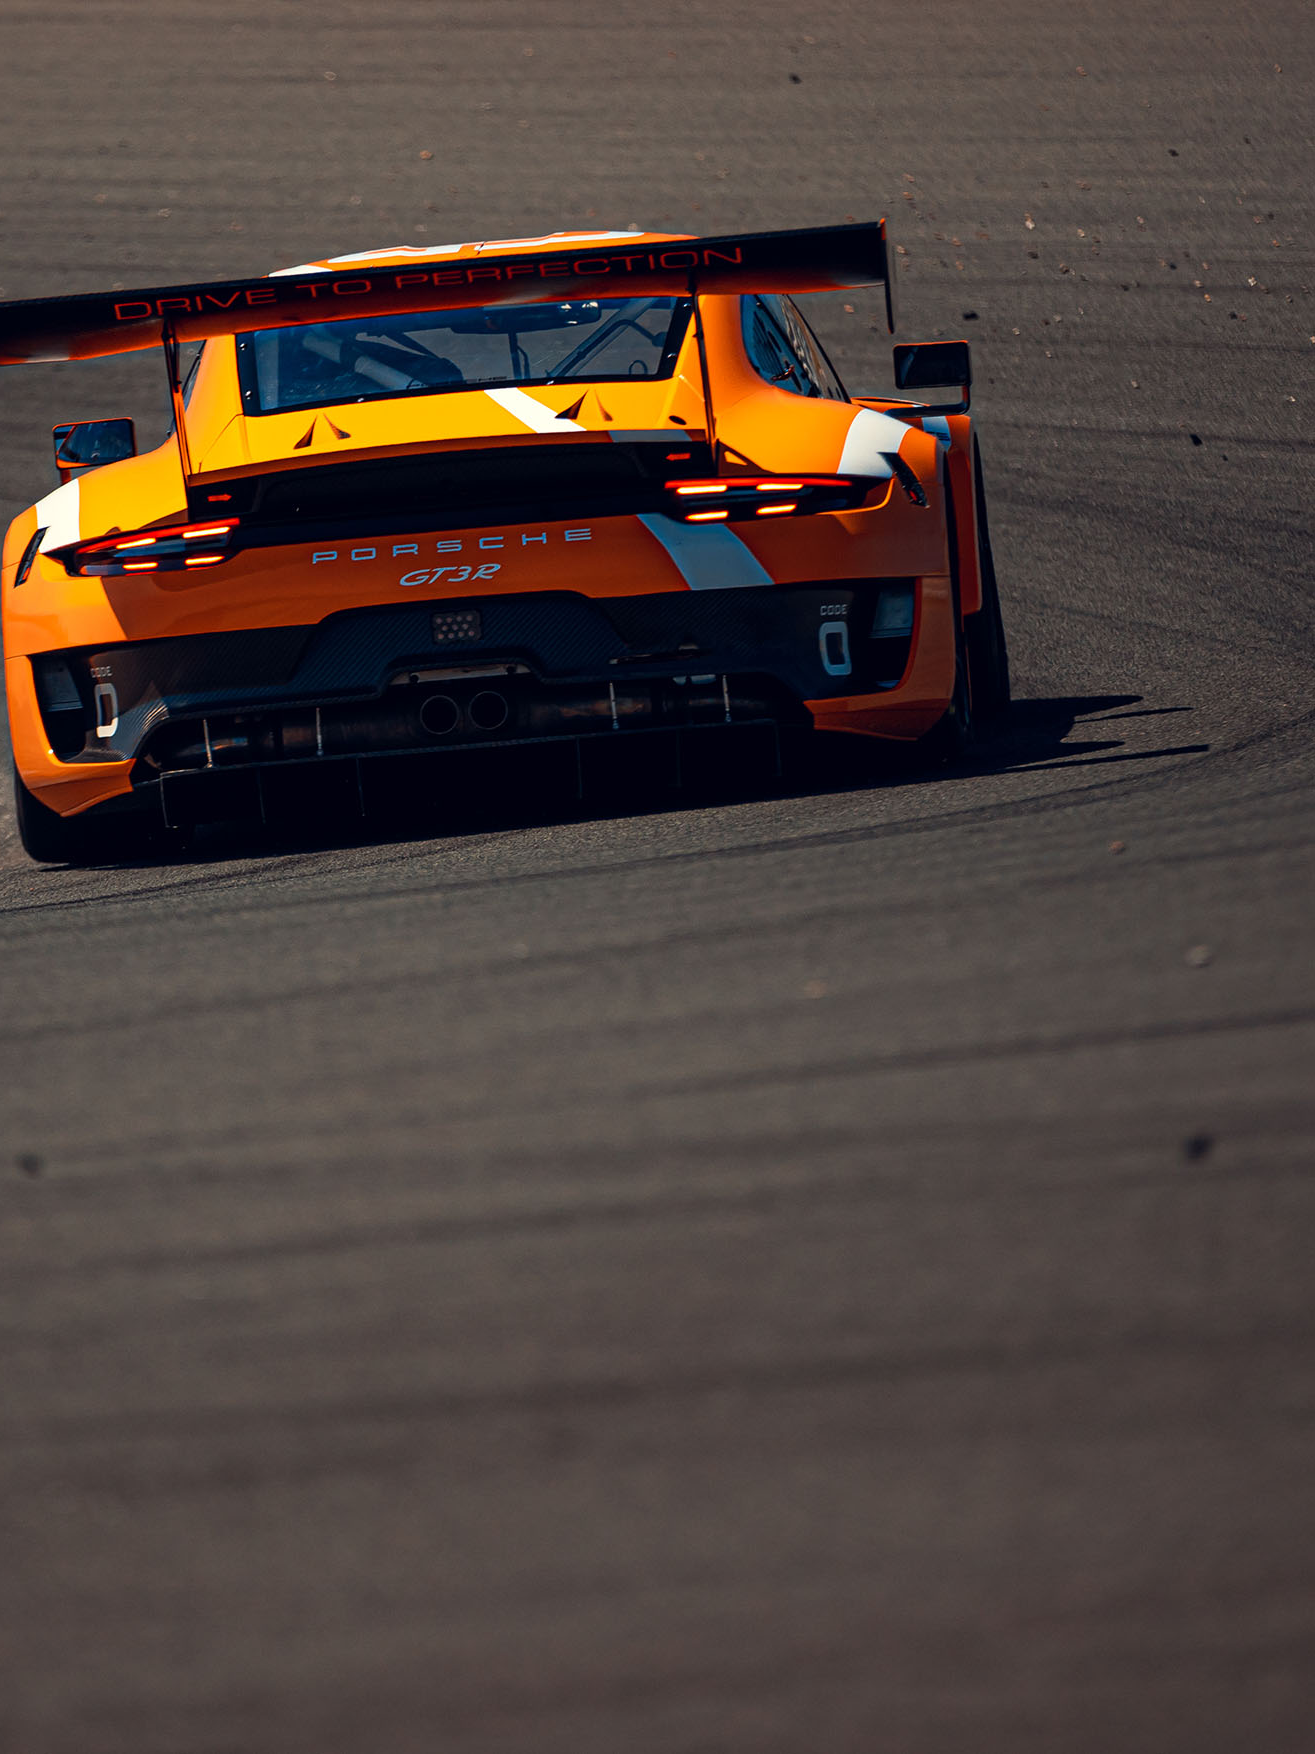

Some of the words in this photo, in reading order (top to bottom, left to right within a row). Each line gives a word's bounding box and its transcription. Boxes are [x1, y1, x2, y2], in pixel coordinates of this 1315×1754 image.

[114, 287, 277, 320] DRIVE
[295, 279, 372, 298] TO
[395, 247, 742, 289] PERFECTION
[312, 528, 592, 564] PORSCHE
[399, 563, 501, 586] GT3R
[820, 603, 848, 616] CODE
